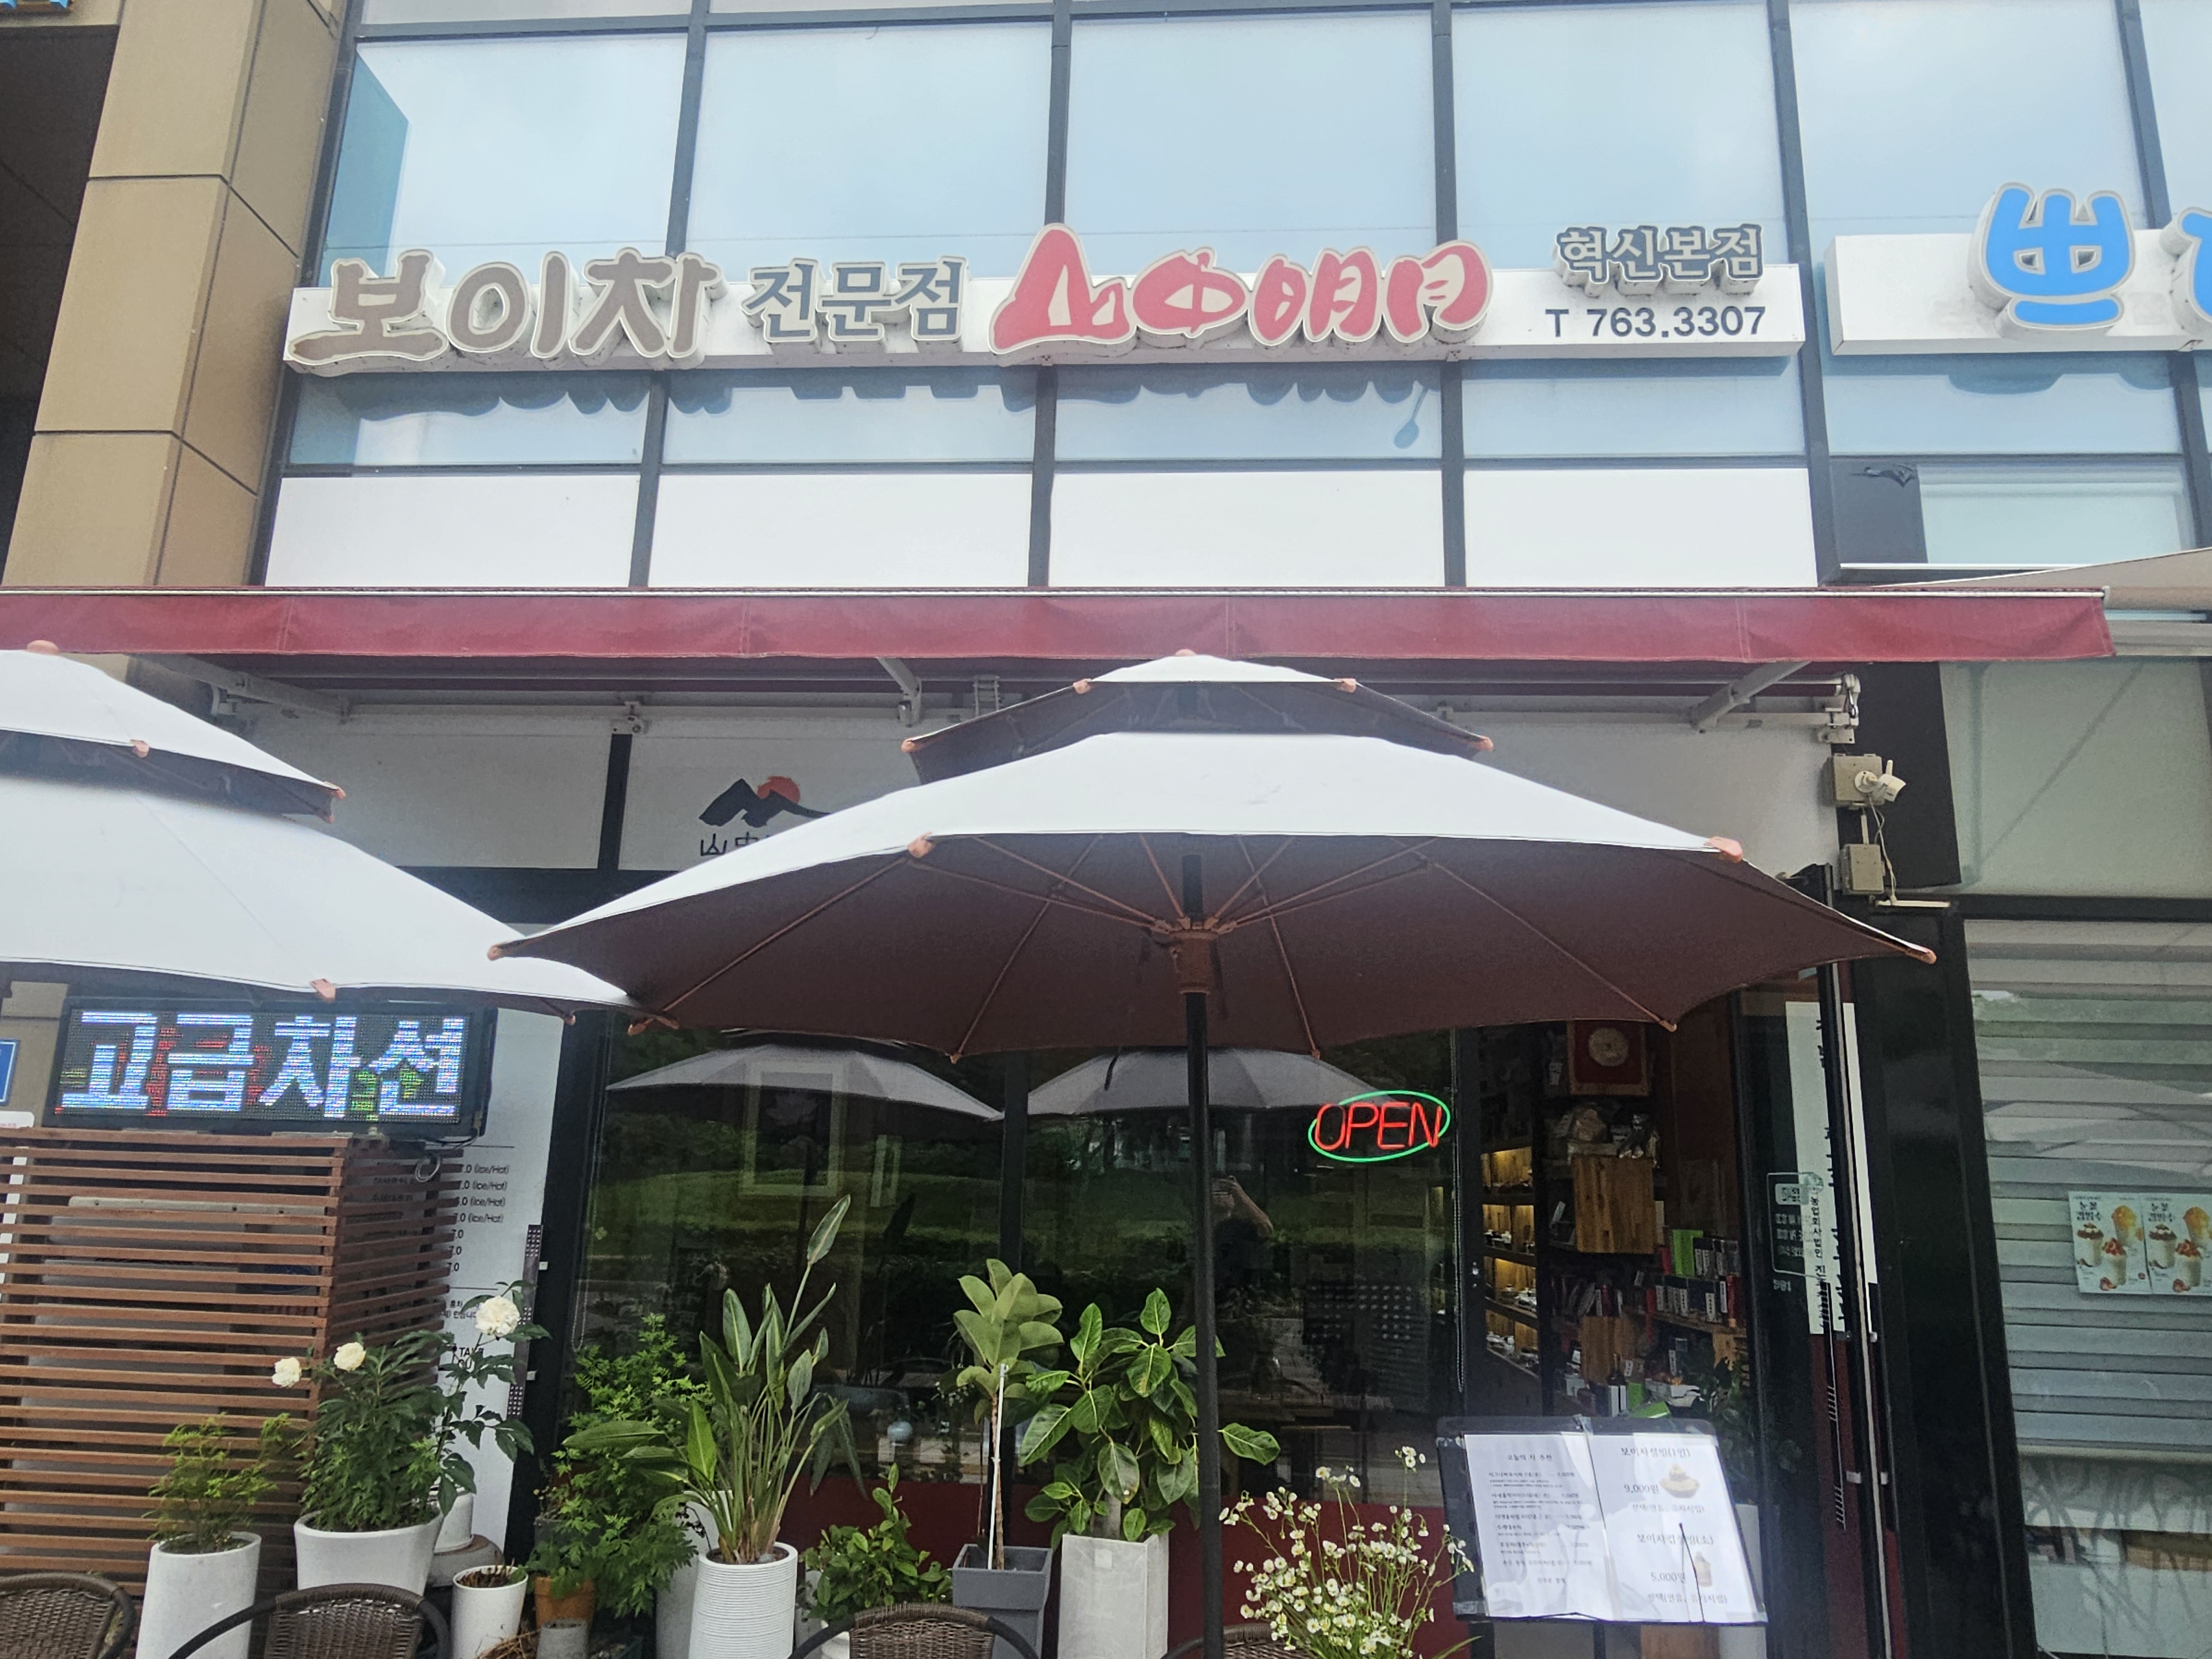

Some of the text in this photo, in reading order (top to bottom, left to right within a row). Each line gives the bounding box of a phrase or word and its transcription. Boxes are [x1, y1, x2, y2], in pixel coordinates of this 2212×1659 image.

[1556, 224, 1763, 283] 혁신본점
[286, 248, 721, 365] 보이차
[742, 257, 968, 343] 전문점
[1545, 306, 1766, 338] T 763.3307
[700, 832, 773, 857] 山中
[1314, 1102, 1442, 1151] OPEN
